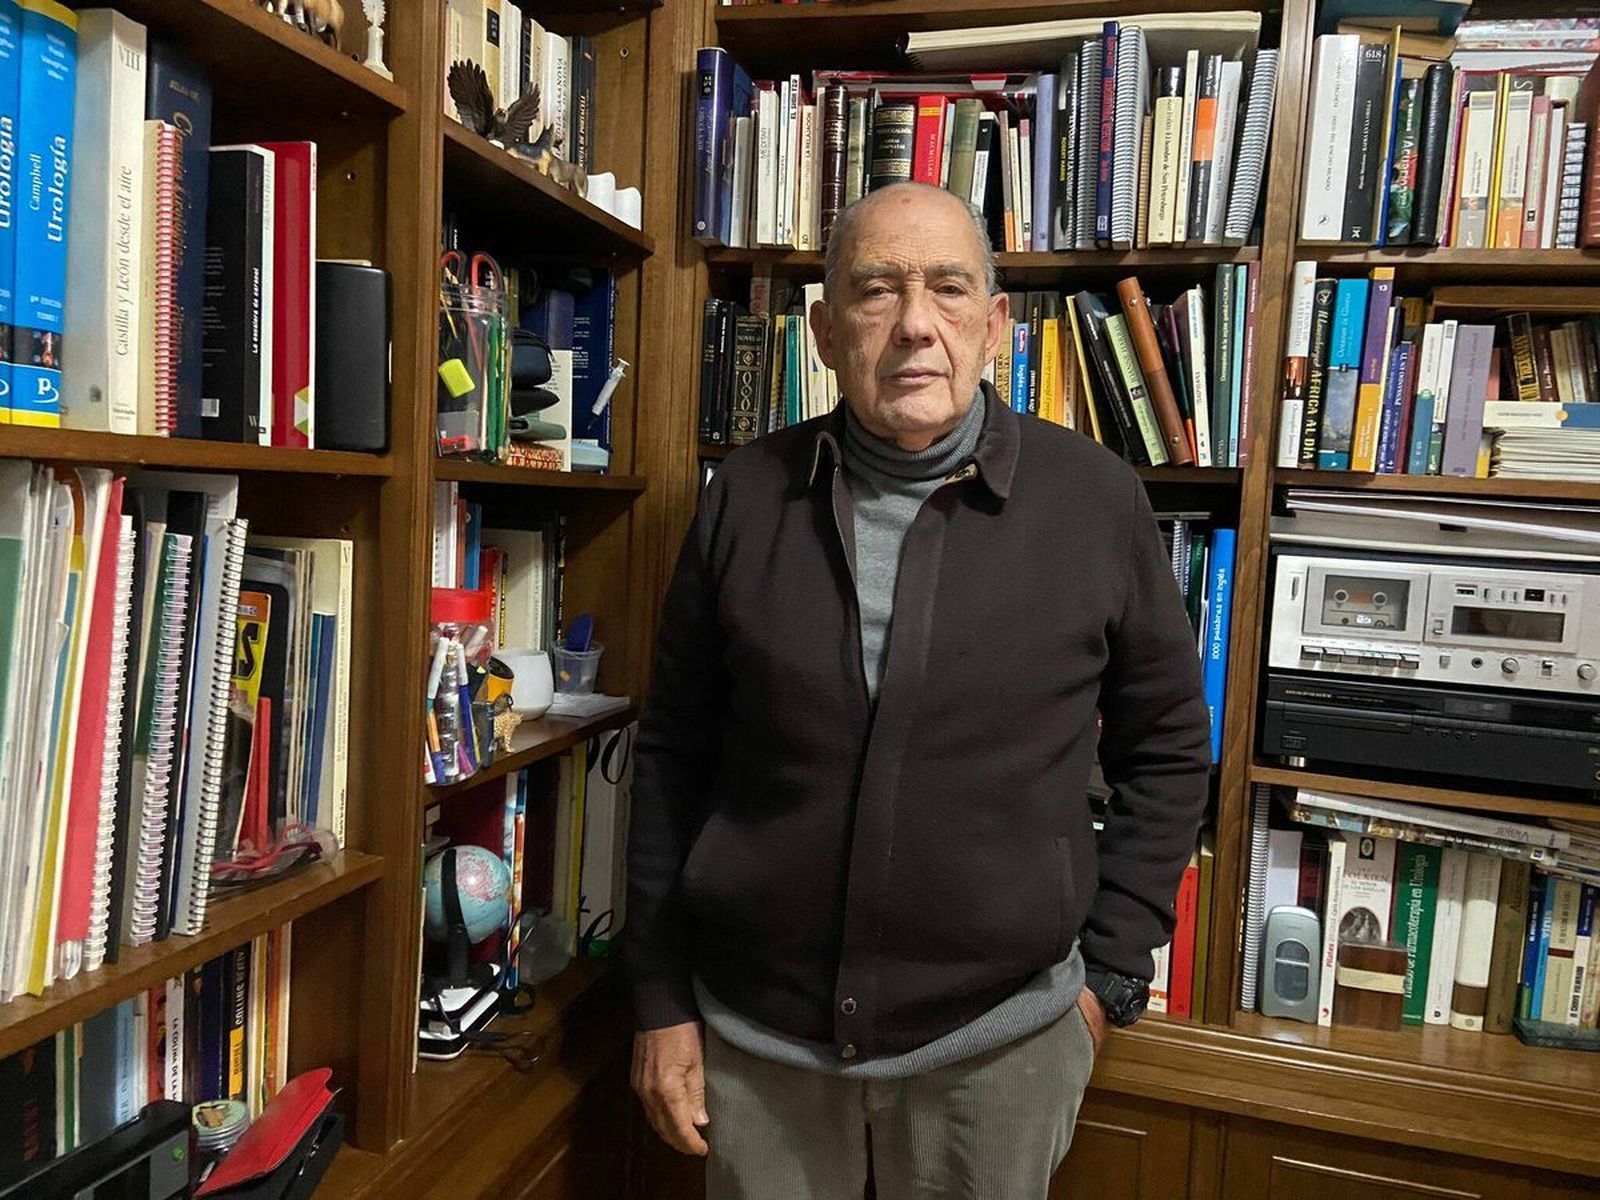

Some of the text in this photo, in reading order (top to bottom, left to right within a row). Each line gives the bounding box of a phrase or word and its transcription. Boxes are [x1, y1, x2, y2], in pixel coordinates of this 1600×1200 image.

[118, 44, 141, 71] VIII
[1365, 49, 1382, 59] 618
[790, 111, 797, 120] EL
[805, 150, 812, 158] LA
[928, 133, 938, 177] MACMILLAN
[1163, 140, 1171, 163] hombre
[28, 153, 43, 211] Campbell
[47, 135, 68, 243] Urología
[114, 166, 133, 356] Castilla y León desde el aire
[252, 344, 259, 354] La
[1305, 419, 1317, 435] AL
[1211, 568, 1227, 660] 1000 palabras en inglés
[1412, 888, 1422, 898] en
[1325, 943, 1335, 968] Pilates
[235, 982, 245, 1026] COLLINS
[171, 1017, 180, 1027] LA
[171, 1030, 180, 1061] COLINA
[171, 1065, 180, 1077] DE
